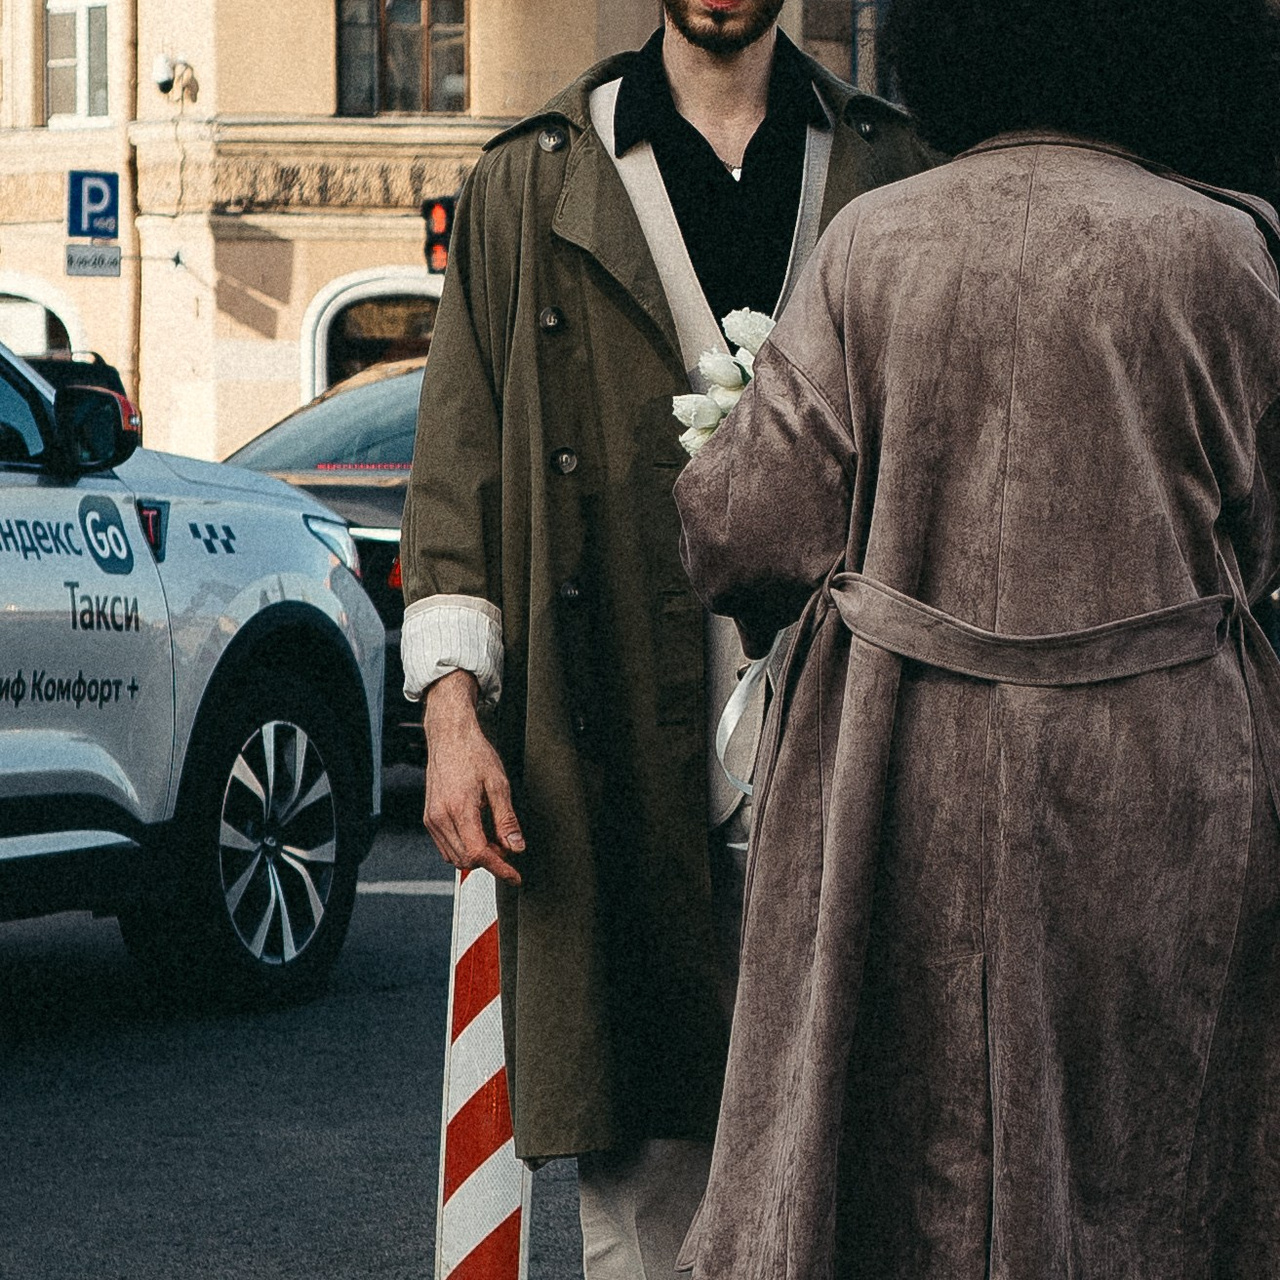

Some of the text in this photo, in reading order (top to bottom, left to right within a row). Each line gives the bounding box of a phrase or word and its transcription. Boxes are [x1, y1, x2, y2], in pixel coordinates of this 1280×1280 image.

[81, 176, 112, 232] P
[0, 510, 128, 561] ндекс Go
[63, 581, 140, 632] Такси
[30, 669, 123, 710] Комфорт
